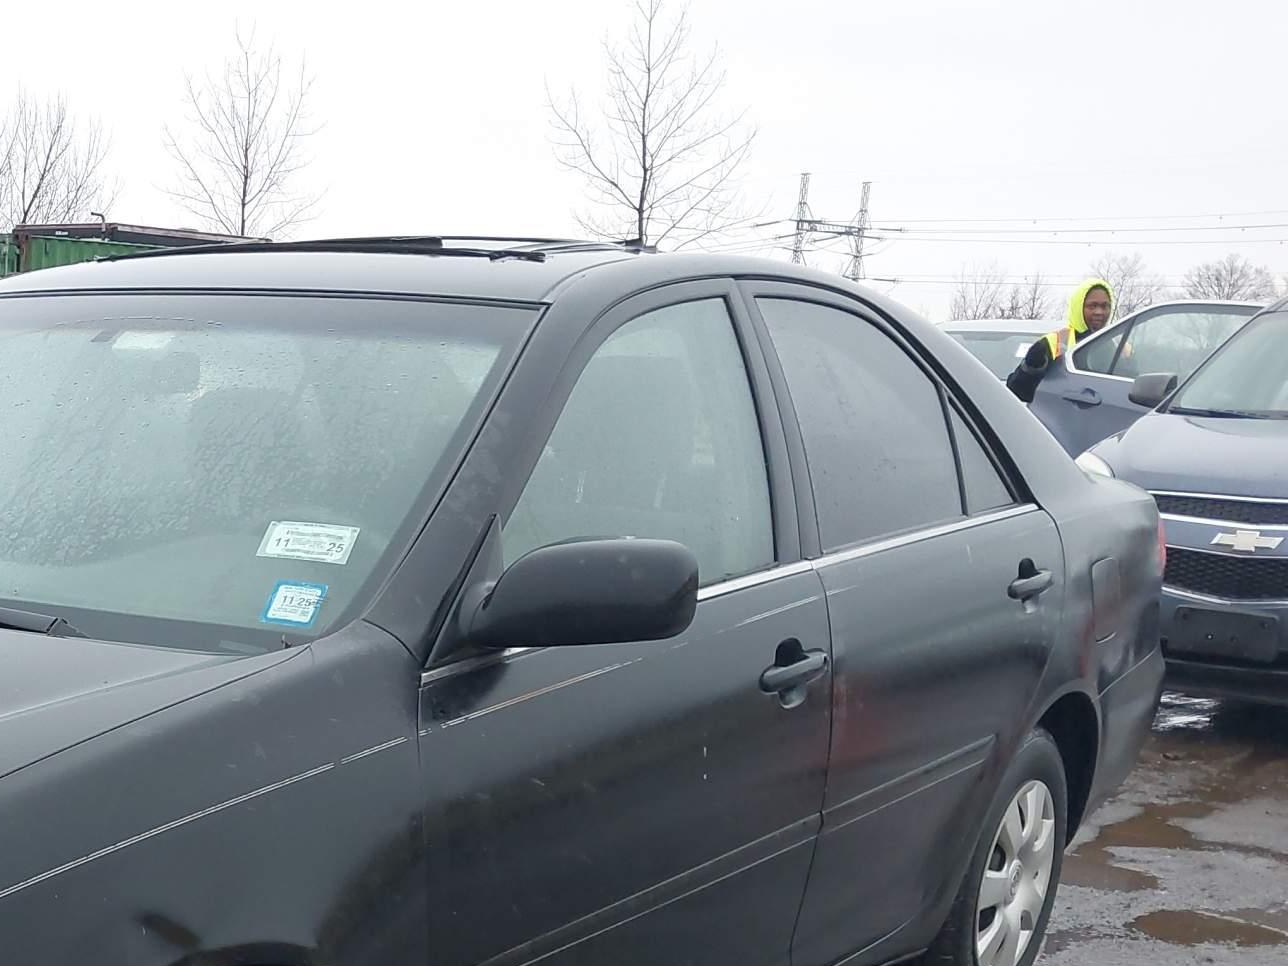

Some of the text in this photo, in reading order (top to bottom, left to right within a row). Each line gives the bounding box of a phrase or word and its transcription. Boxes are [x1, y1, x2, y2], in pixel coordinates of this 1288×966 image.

[274, 537, 291, 548] 11
[326, 542, 345, 553] 25
[297, 597, 312, 607] 25
